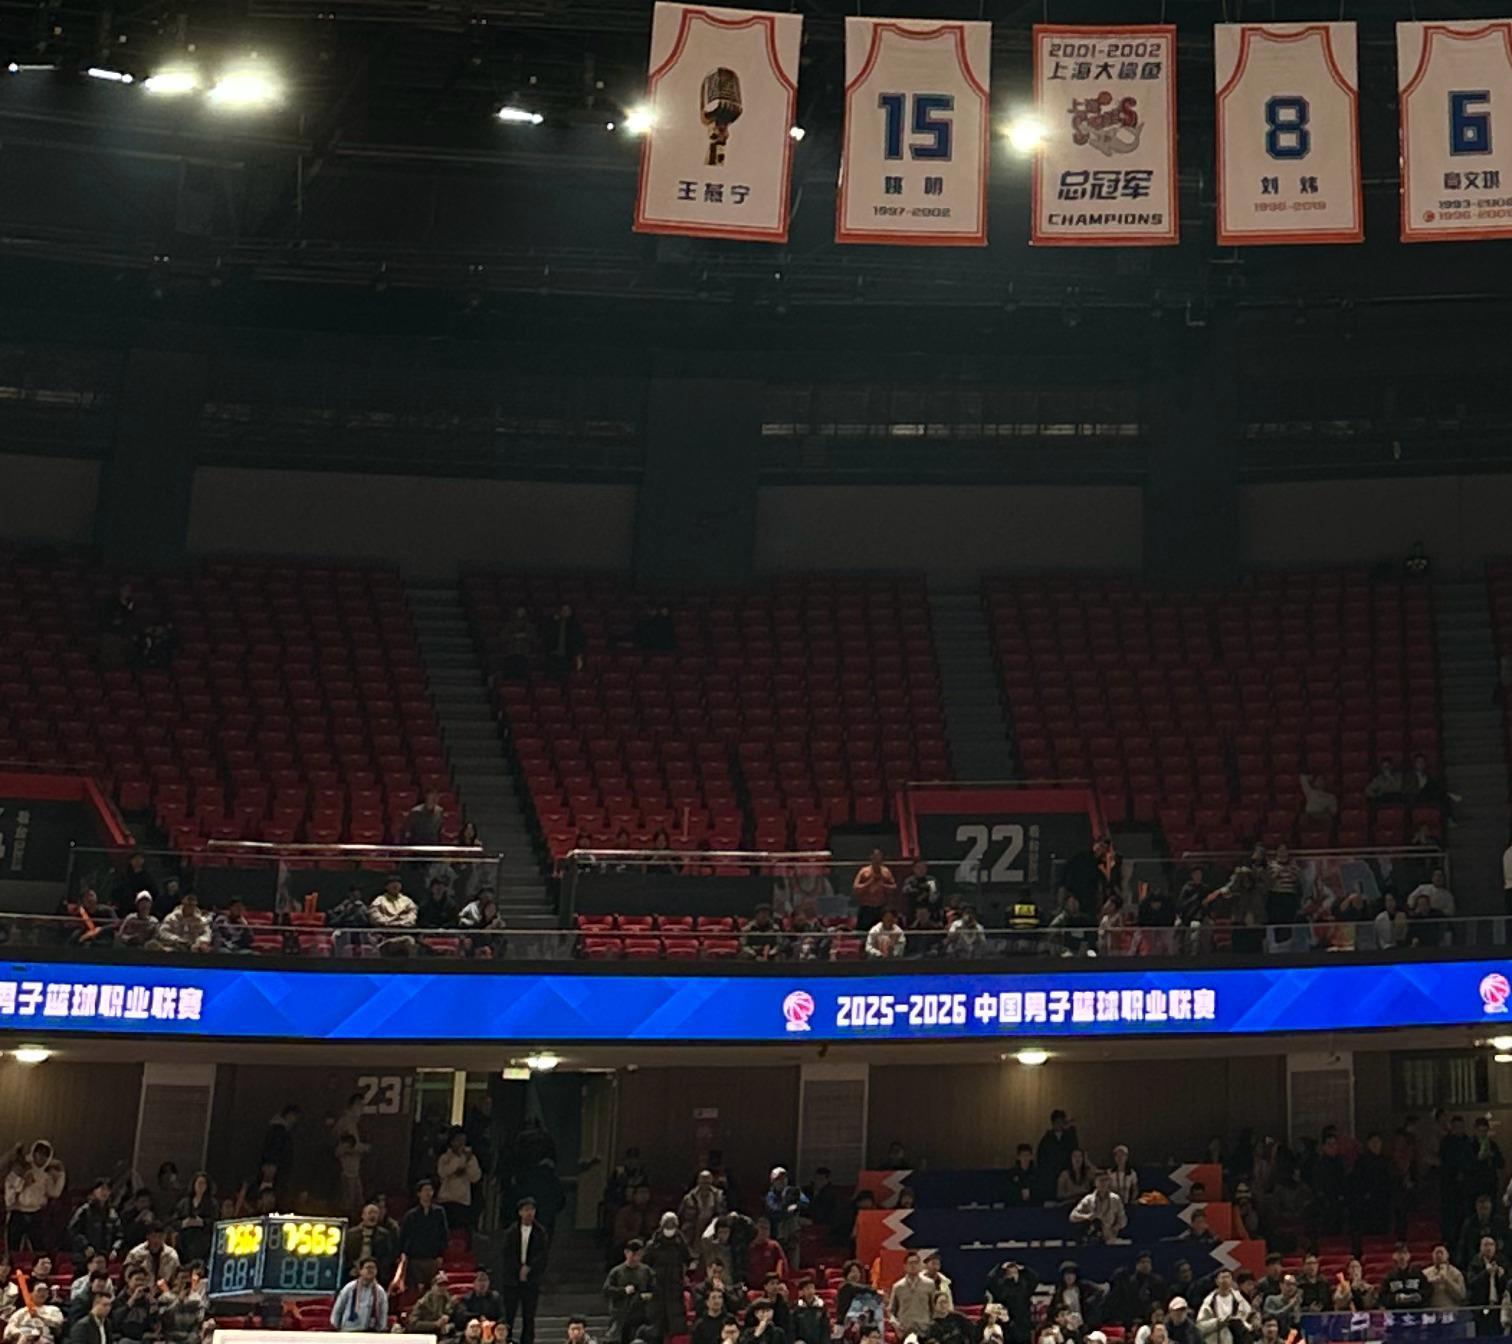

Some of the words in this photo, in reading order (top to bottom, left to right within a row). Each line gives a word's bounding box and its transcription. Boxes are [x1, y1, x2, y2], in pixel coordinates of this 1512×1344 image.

[1049, 42, 1162, 58] 2001-2002
[1047, 61, 1163, 81] 上海大鲨鱼
[878, 93, 955, 162] 15
[1265, 95, 1310, 160] 8
[1449, 90, 1493, 155] 6
[1058, 170, 1154, 201] 总冠军
[1048, 213, 1163, 226] CHAMPIONS
[954, 824, 1025, 883] 22
[836, 994, 966, 1026] 2025-2026
[974, 988, 1215, 1024] 中国男子篮球职业联赛
[358, 1076, 402, 1115] 23
